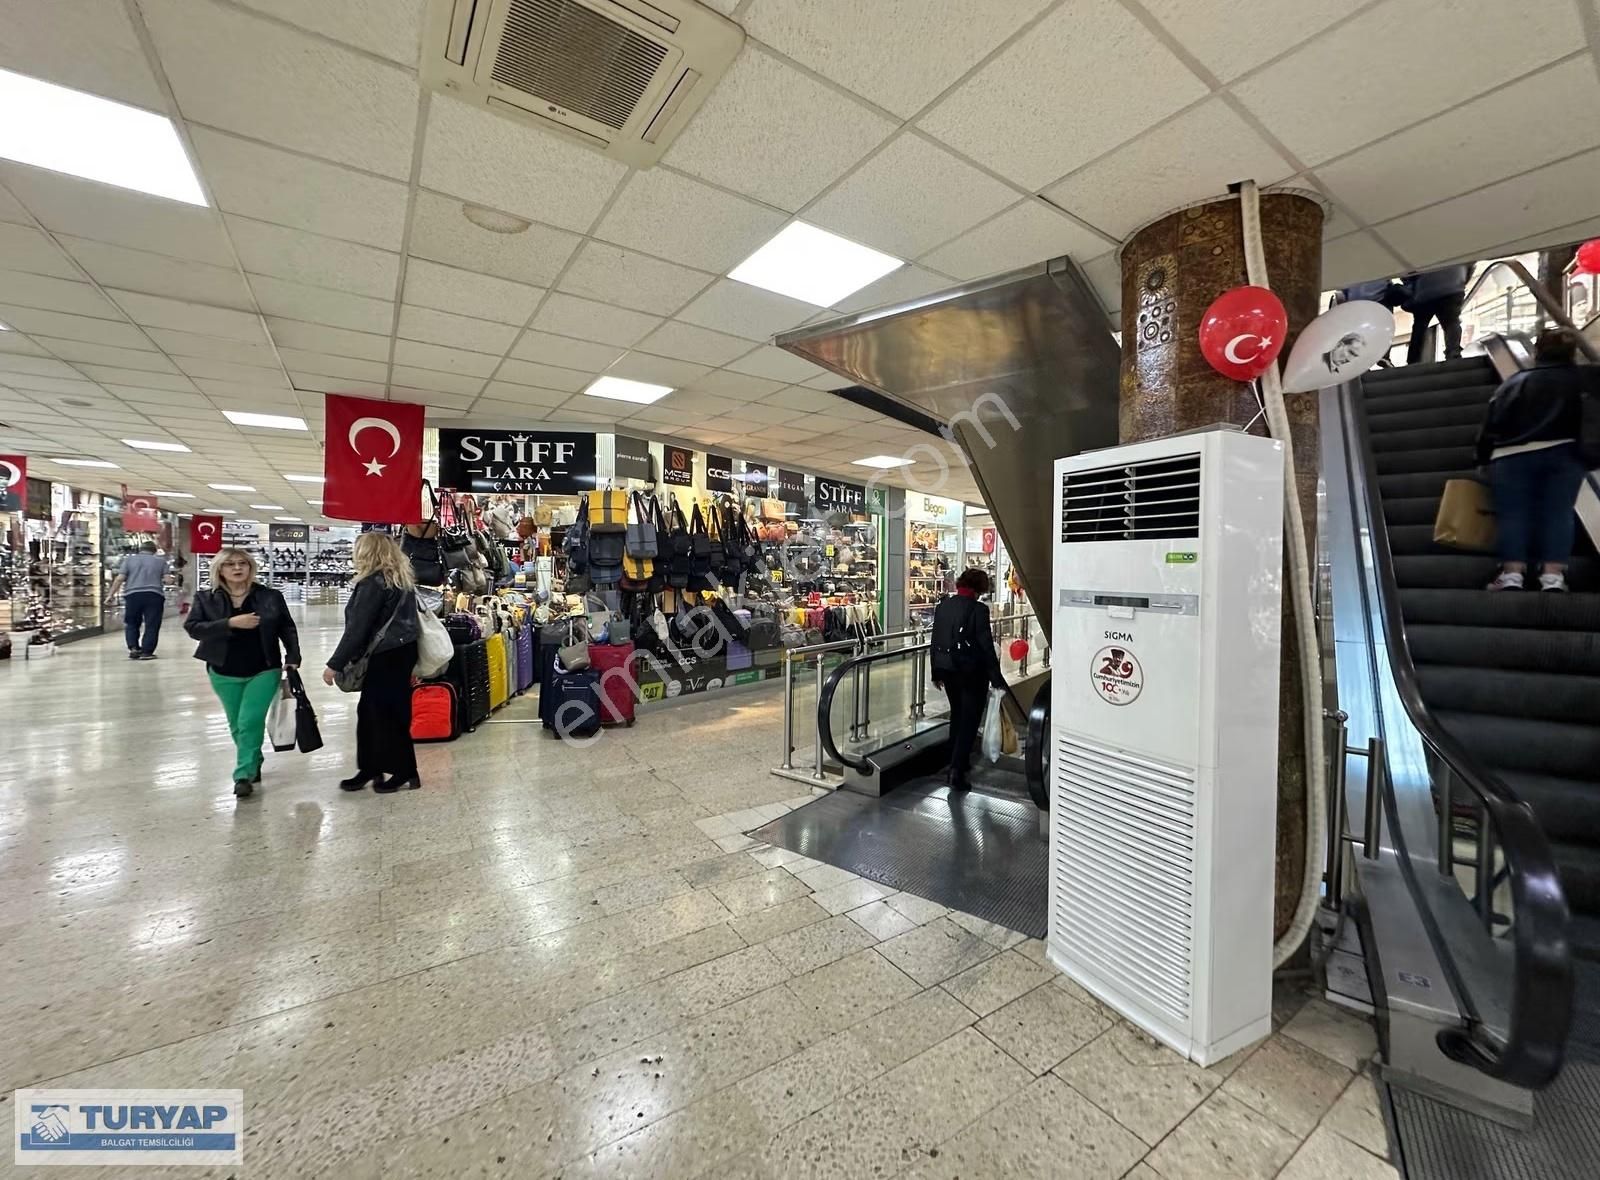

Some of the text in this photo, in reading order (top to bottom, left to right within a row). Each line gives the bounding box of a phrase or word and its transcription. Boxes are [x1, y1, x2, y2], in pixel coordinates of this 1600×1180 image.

[459, 434, 576, 465] STIFF
[484, 465, 551, 480] LARA
[664, 468, 692, 479] MCS
[707, 467, 730, 480] CCS
[493, 482, 544, 491] ÇANTA
[819, 482, 863, 505] STIFF
[828, 503, 853, 514] LARA
[1104, 630, 1134, 643] SIGMA
[678, 656, 697, 666] CCS
